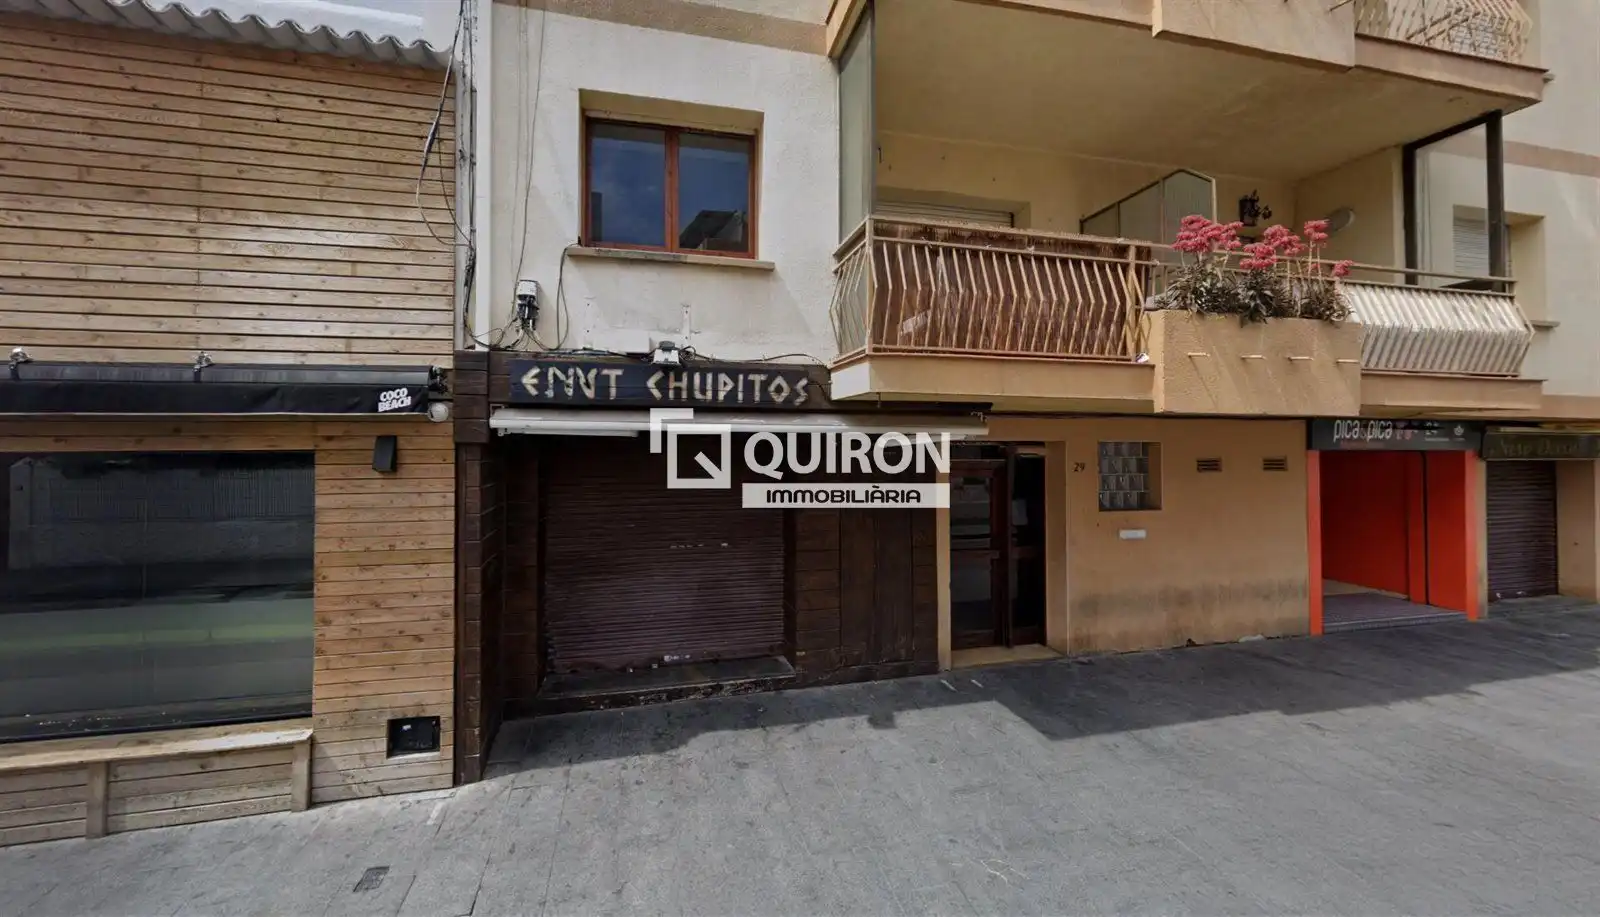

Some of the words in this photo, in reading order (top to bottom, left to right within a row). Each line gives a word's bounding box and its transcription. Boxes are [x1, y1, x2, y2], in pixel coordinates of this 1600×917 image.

[380, 388, 408, 401] COCO
[646, 370, 809, 406] CHUPITOS
[378, 396, 411, 412] BEACH
